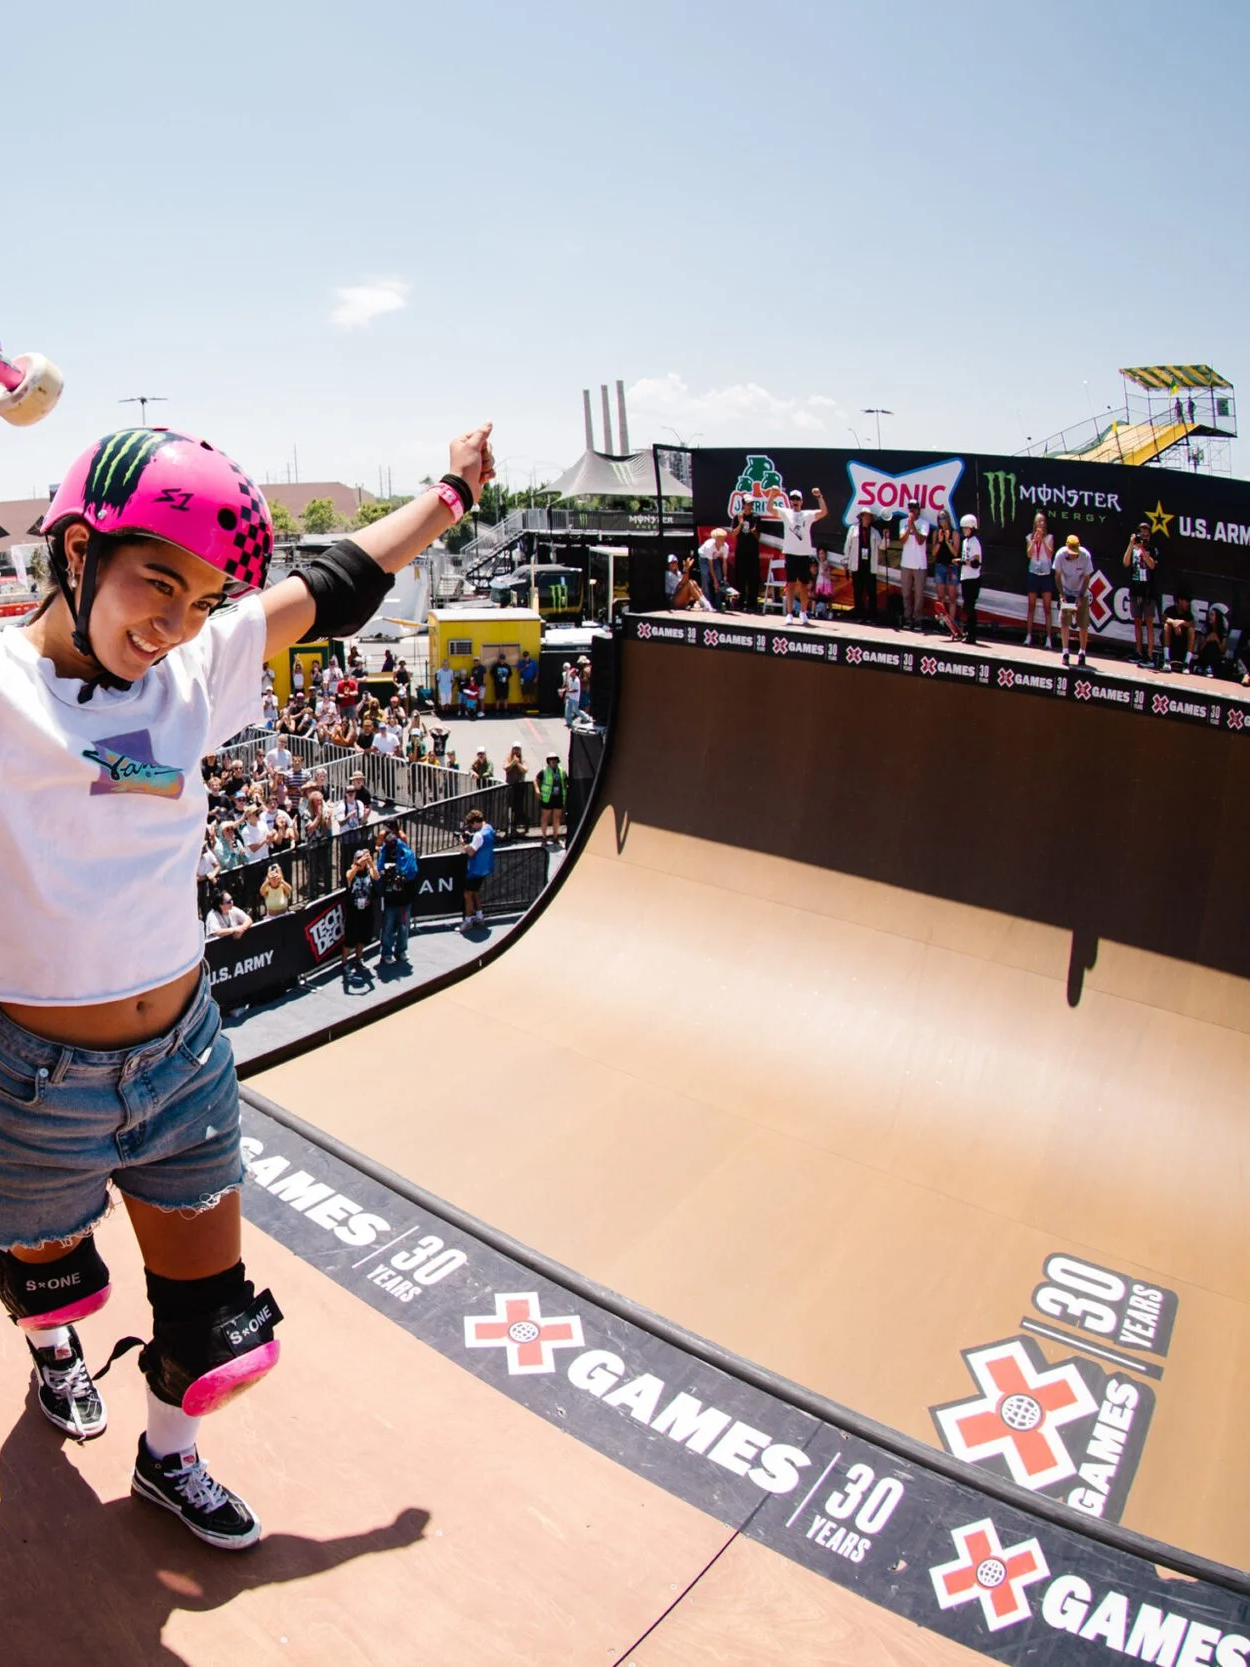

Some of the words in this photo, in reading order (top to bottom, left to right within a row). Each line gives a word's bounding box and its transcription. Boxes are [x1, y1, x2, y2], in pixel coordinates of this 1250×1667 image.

[857, 481, 947, 511] SONIC
[1019, 483, 1122, 512] MONSTER
[1179, 515, 1211, 540] U.S.
[651, 626, 685, 639] GAMES
[718, 634, 753, 647] GAMES
[788, 641, 825, 656] GAMES
[862, 650, 900, 666] GAMES
[937, 662, 976, 677] GAMES
[1014, 674, 1053, 689] GAMES
[1092, 686, 1131, 703] GAMES
[1169, 700, 1207, 718] GAMES
[234, 950, 274, 978] ARMY
[390, 1235, 468, 1286] 30
[366, 1264, 422, 1303] YEARS
[1036, 1256, 1126, 1334] 30
[1119, 1284, 1164, 1348] YEARS
[566, 1349, 811, 1495] GAMES
[824, 1463, 905, 1535] 30
[1067, 1379, 1140, 1517] GAMES
[804, 1515, 873, 1565] YEARS
